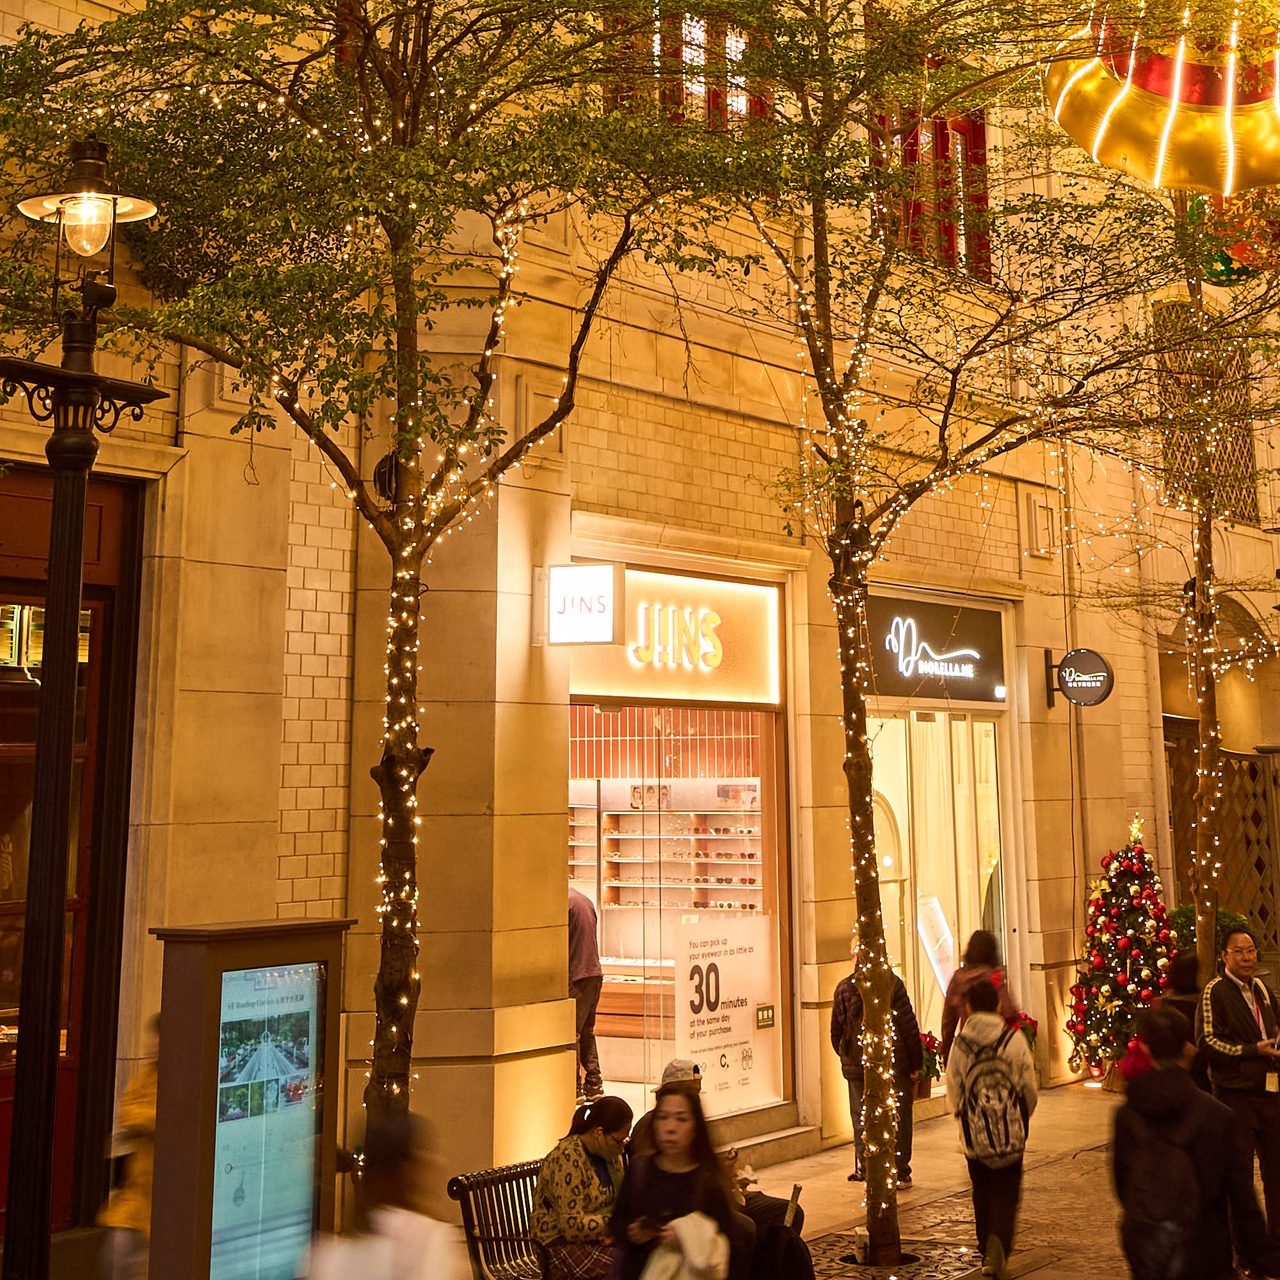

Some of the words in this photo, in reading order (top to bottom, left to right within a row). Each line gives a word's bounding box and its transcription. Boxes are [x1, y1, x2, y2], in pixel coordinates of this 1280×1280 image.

[689, 940, 699, 949] You
[710, 938, 720, 949] pick
[721, 938, 728, 947] up
[689, 953, 700, 963] your
[702, 950, 722, 961] eyewear
[689, 962, 720, 1015] 30
[721, 996, 748, 1010] minutes
[689, 1019, 695, 1028] at
[697, 1018, 705, 1026] the
[706, 1017, 720, 1025] same
[721, 1013, 730, 1023] day
[689, 1030, 695, 1039] of
[697, 1030, 708, 1040] your
